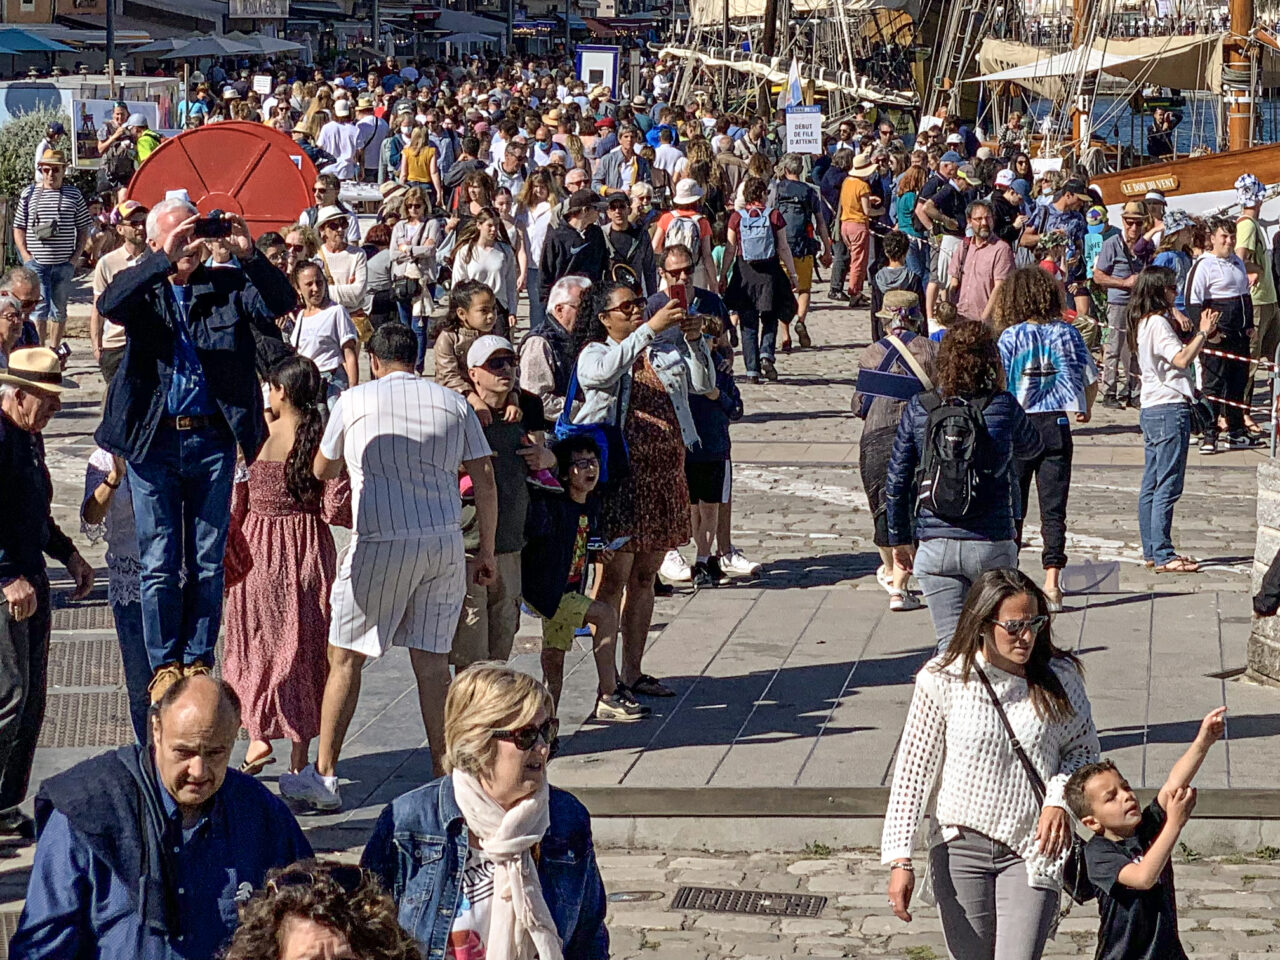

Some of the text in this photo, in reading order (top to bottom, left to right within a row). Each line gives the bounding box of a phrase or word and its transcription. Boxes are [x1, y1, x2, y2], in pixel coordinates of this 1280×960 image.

[1122, 178, 1175, 193] LE DON DU VENT
